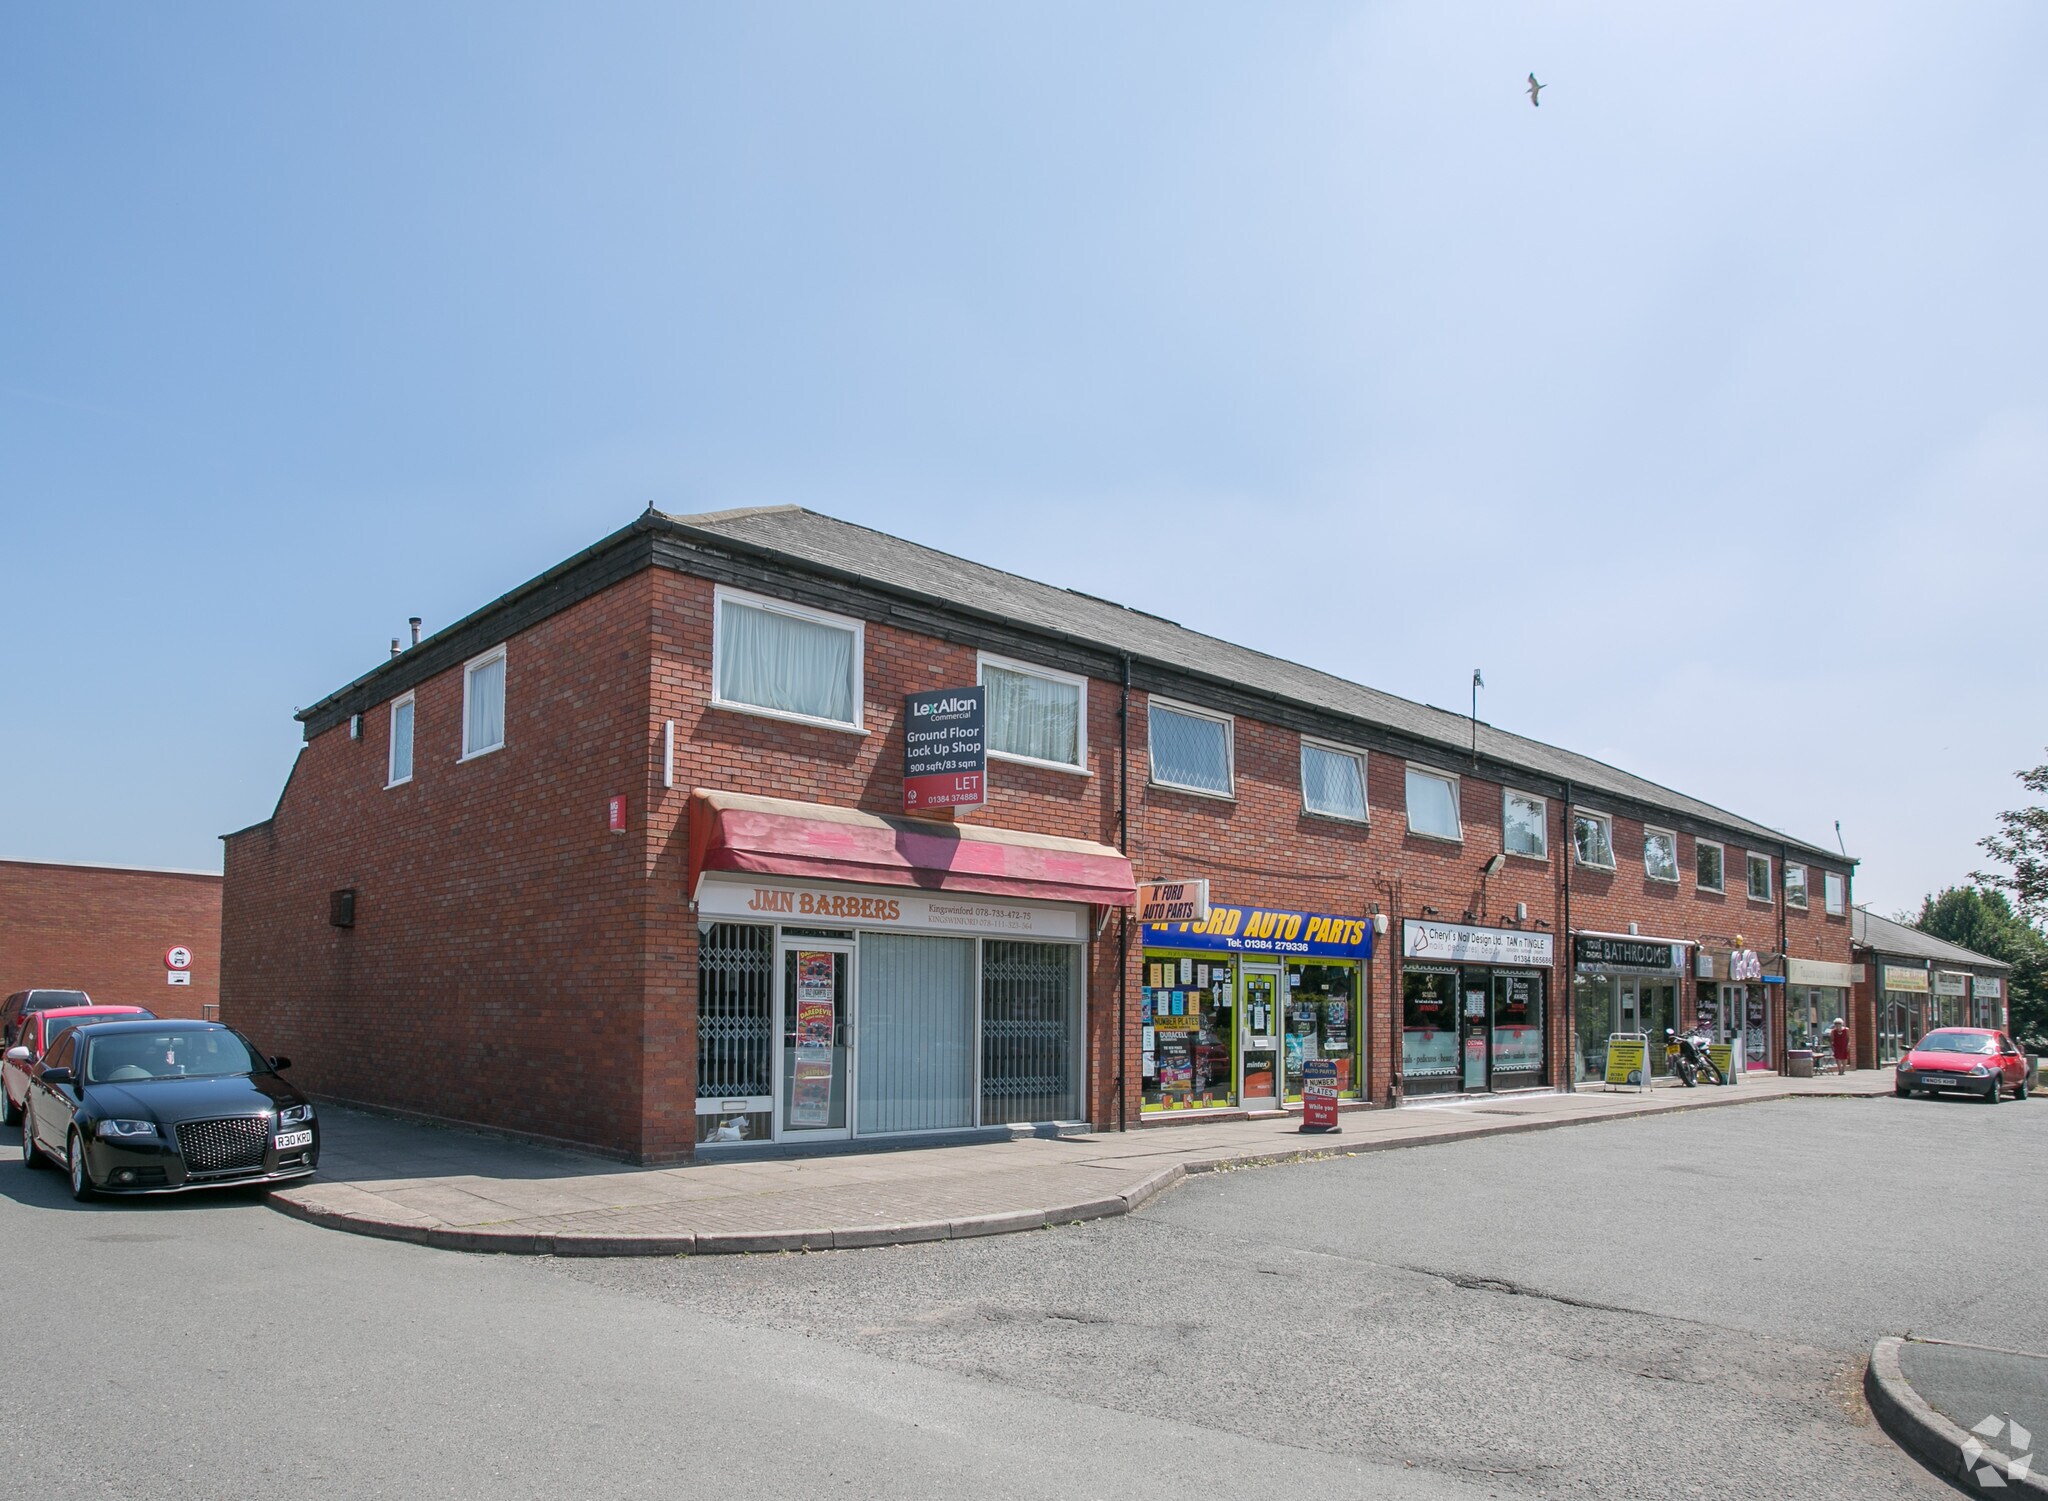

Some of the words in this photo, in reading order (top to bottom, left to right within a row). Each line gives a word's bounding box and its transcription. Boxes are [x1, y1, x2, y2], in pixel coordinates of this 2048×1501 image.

[930, 712, 971, 722] Commercial
[907, 728, 947, 742] Ground
[950, 726, 979, 739] Floor
[907, 745, 931, 758] Lock
[934, 744, 949, 756] Up
[952, 742, 981, 754] Shop
[910, 764, 925, 772] 900
[926, 760, 956, 771] sqft/83
[958, 760, 977, 769] sqm
[955, 776, 979, 790] LET
[928, 795, 949, 804] 01384
[951, 793, 978, 802] 374888
[1162, 885, 1184, 901] FORD
[747, 889, 795, 912] JMN
[799, 892, 900, 921] BARBERS
[929, 904, 974, 915] Kingswinford
[975, 908, 1032, 920] 078-733-472-75
[1143, 903, 1165, 919] AUTO
[1166, 902, 1194, 919] PARTS
[928, 915, 978, 926] KINGSWINFORD
[1243, 911, 1302, 940] AUTO
[1304, 917, 1365, 945] PARTS
[1226, 938, 1241, 948] Tel:
[1244, 939, 1272, 950] 01384
[1275, 941, 1309, 952] 279336
[1429, 942, 1444, 950] nails
[1457, 932, 1470, 942] Nail
[1472, 933, 1491, 946] Design
[1506, 936, 1518, 946] TAN
[1524, 938, 1544, 949] TINGLE
[1514, 955, 1531, 963] 01384
[1604, 942, 1666, 964] BATHROOMS
[800, 1008, 832, 1019] DAREDEVIL
[1155, 1017, 1177, 1026] NUMBER
[1178, 1017, 1198, 1026] PLATES
[1246, 1061, 1267, 1069] mintex
[1309, 1078, 1335, 1086] NUMBER
[1308, 1086, 1333, 1096] PLATES
[278, 1135, 296, 1147] R30
[297, 1132, 311, 1144] KRD
